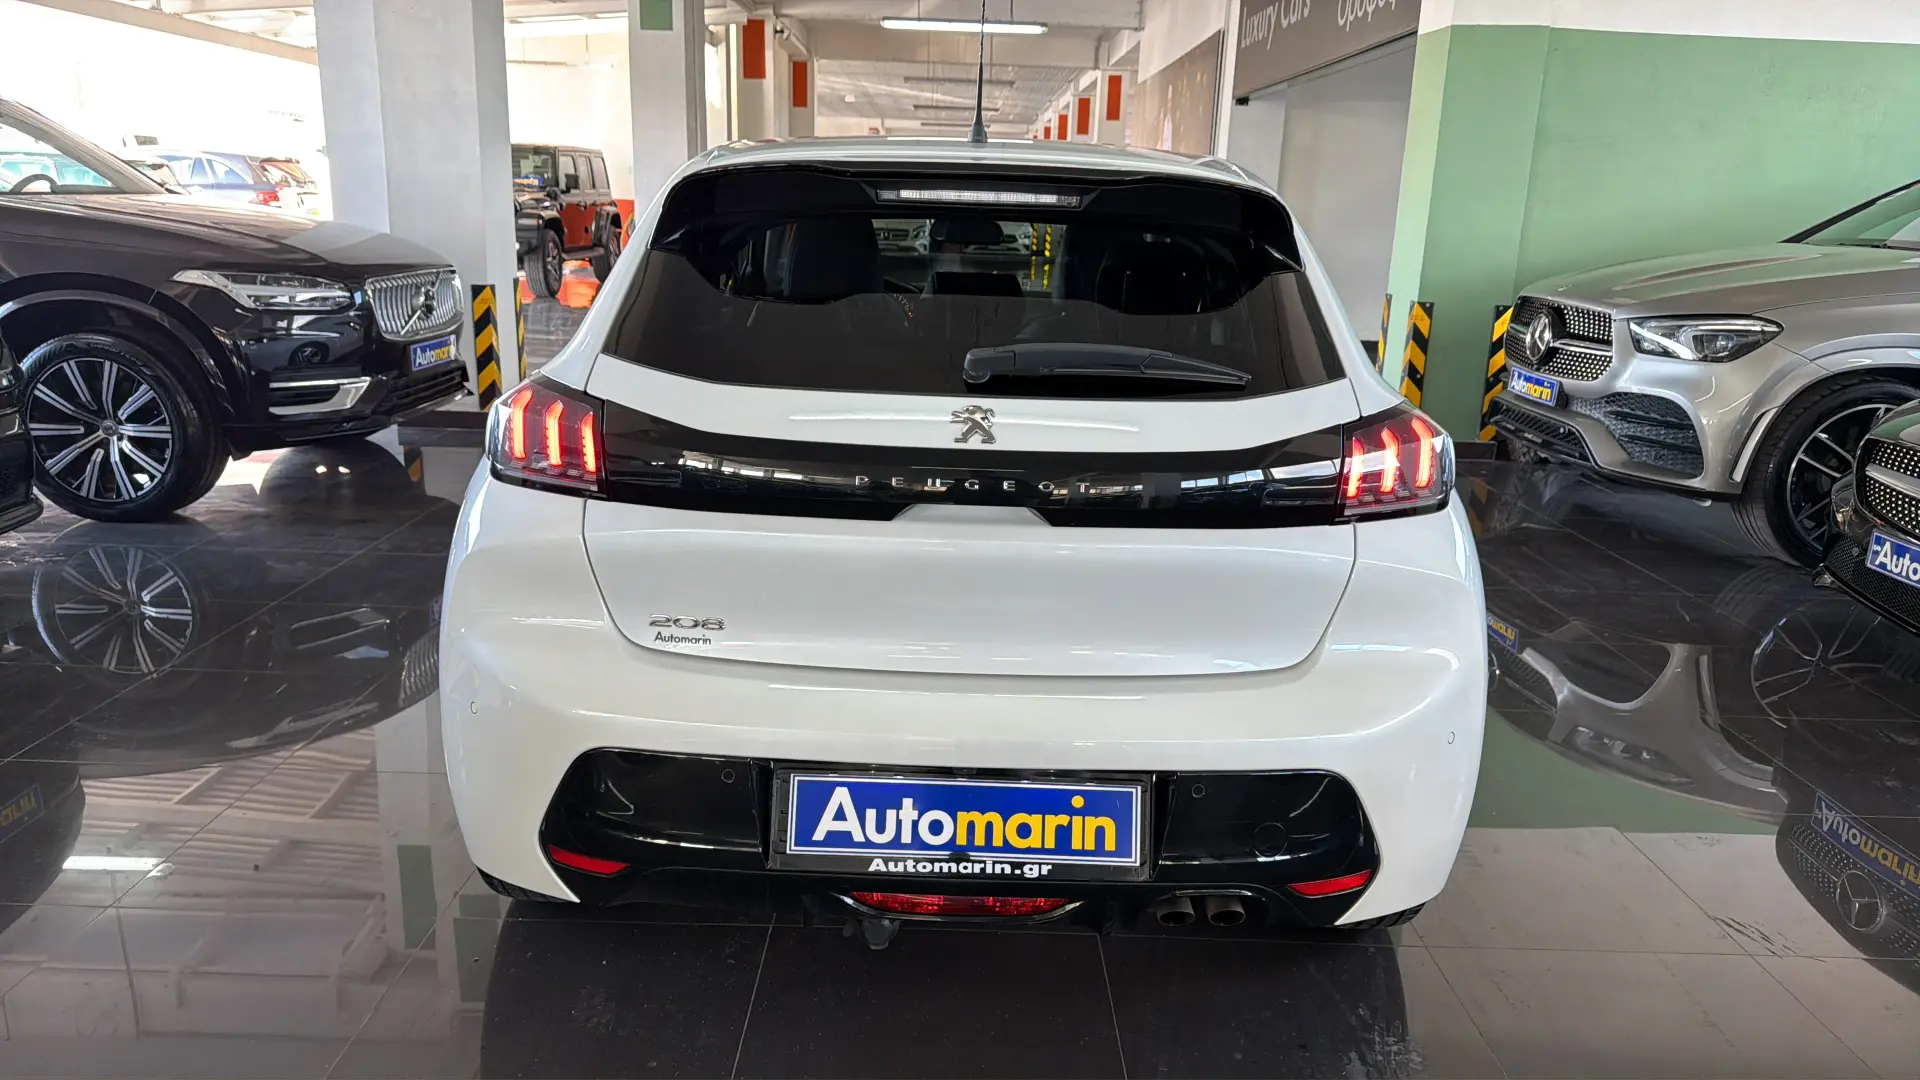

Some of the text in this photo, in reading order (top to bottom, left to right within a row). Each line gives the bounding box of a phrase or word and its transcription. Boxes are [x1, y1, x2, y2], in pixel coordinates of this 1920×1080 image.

[1241, 0, 1310, 50] Luxury Cars
[1511, 371, 1552, 401] Automarin
[855, 475, 1090, 493] PEUGEOT
[649, 614, 726, 631] 208
[654, 631, 712, 645] Automarin
[812, 786, 1116, 851] Automarin
[868, 858, 1052, 878] Automarin.gr
